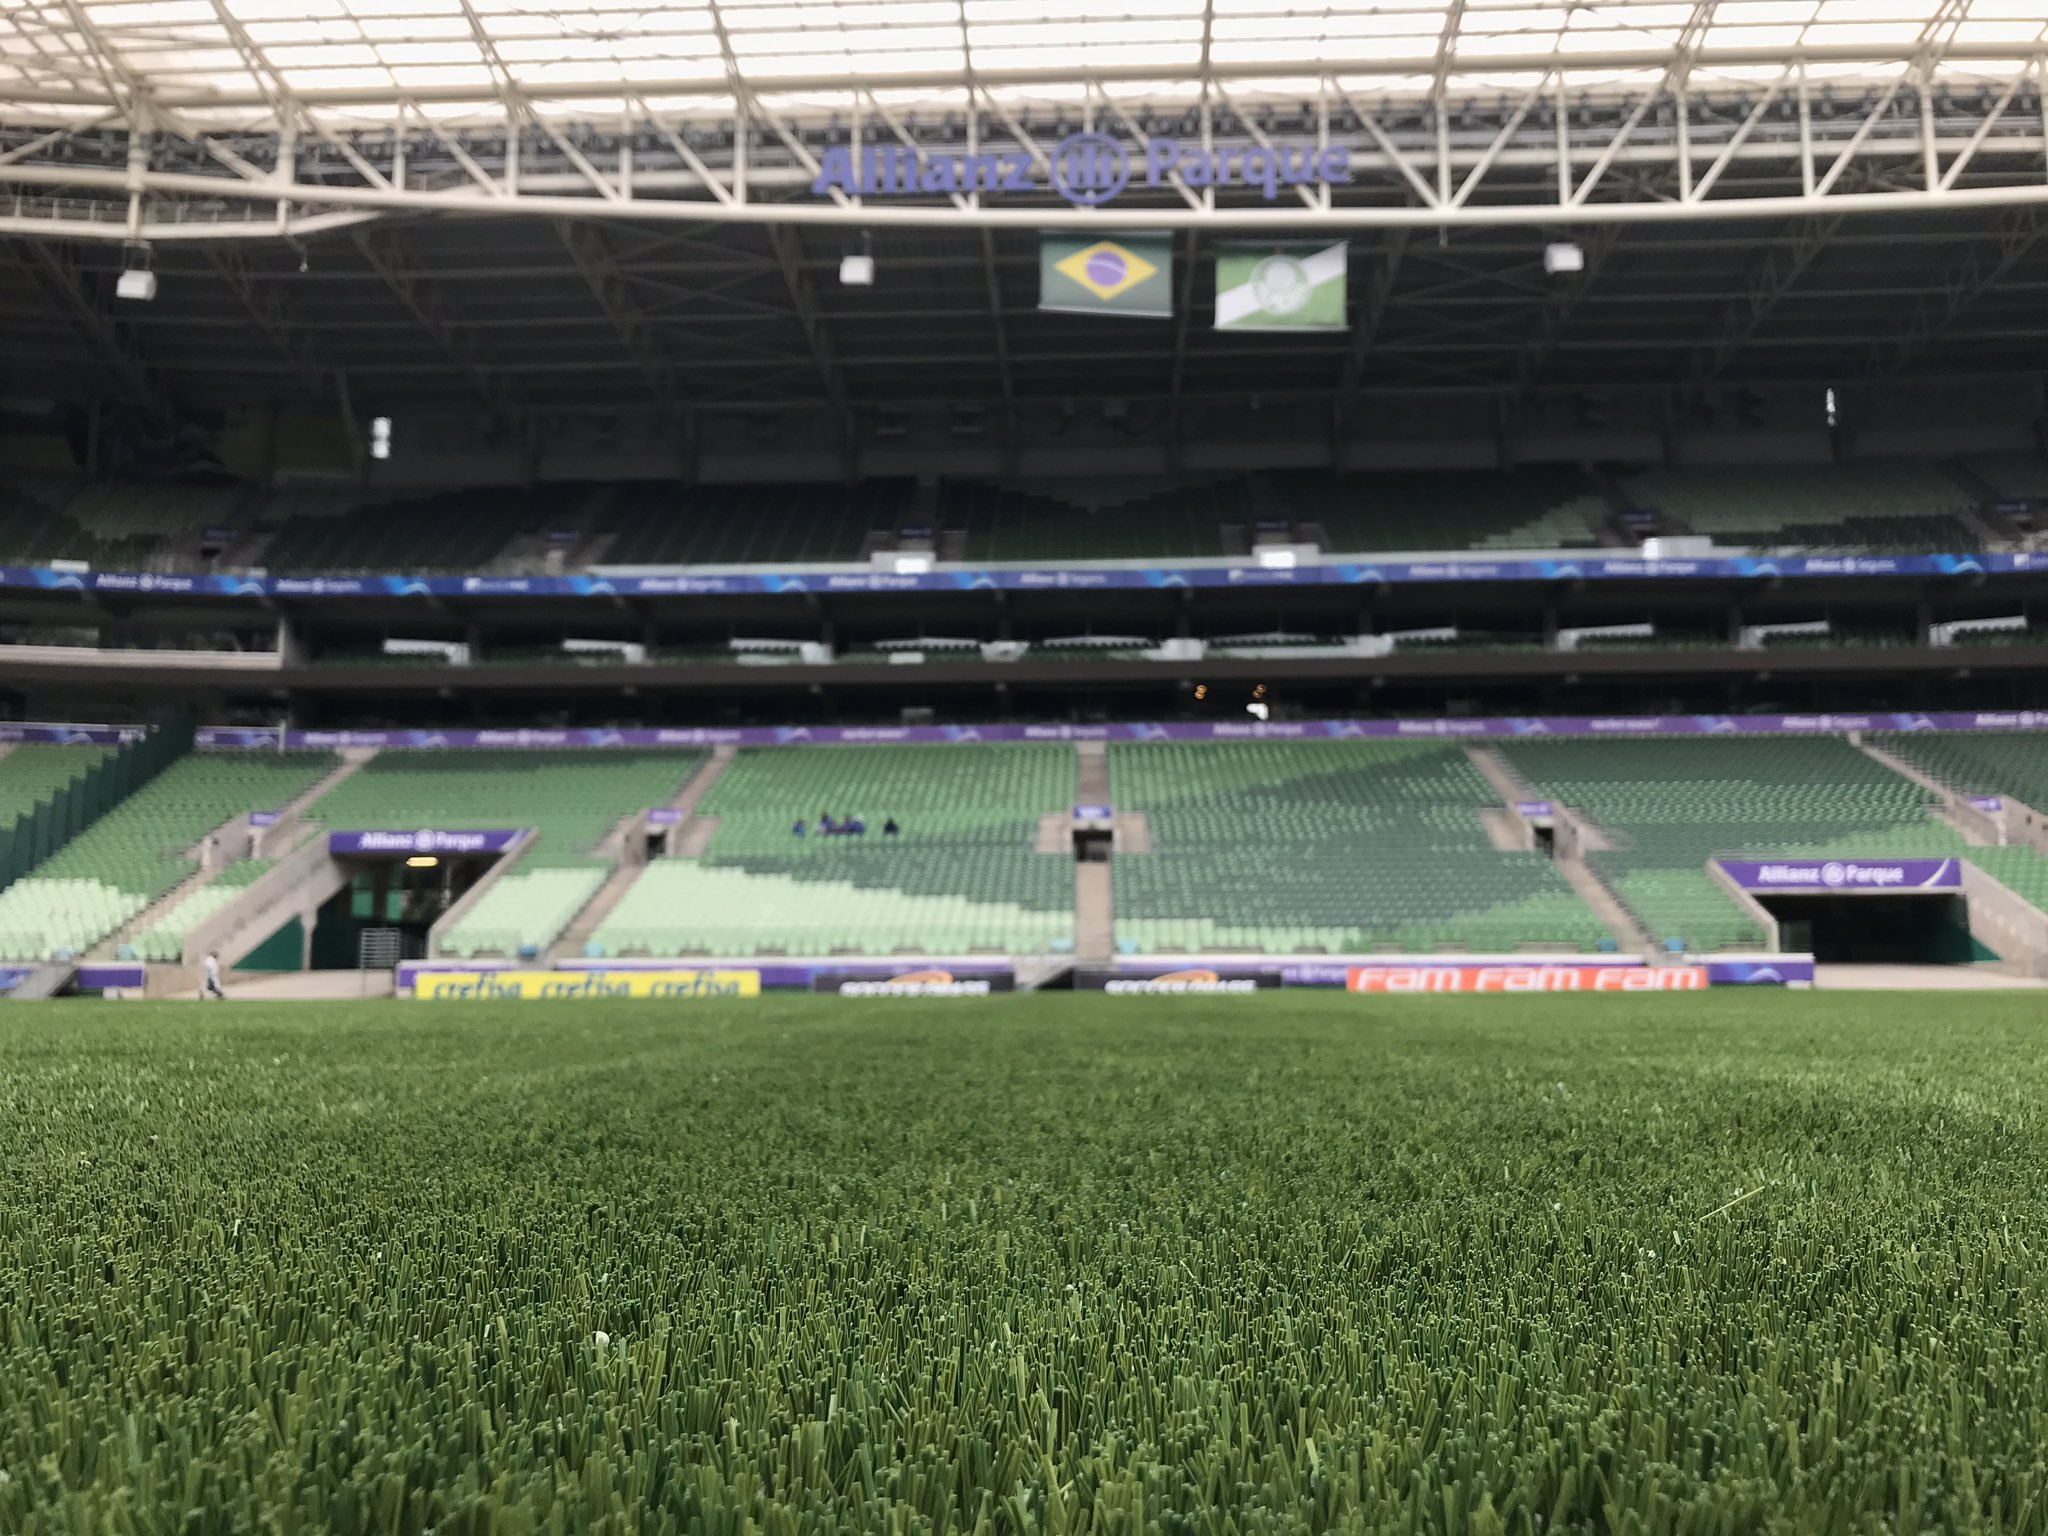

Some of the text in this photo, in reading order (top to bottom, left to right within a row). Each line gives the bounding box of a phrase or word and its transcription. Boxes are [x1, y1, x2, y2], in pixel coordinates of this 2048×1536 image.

[811, 138, 1352, 199] Allianz Parque
[357, 831, 485, 851] Allianz Parque
[1758, 864, 1904, 886] Allianz Parque
